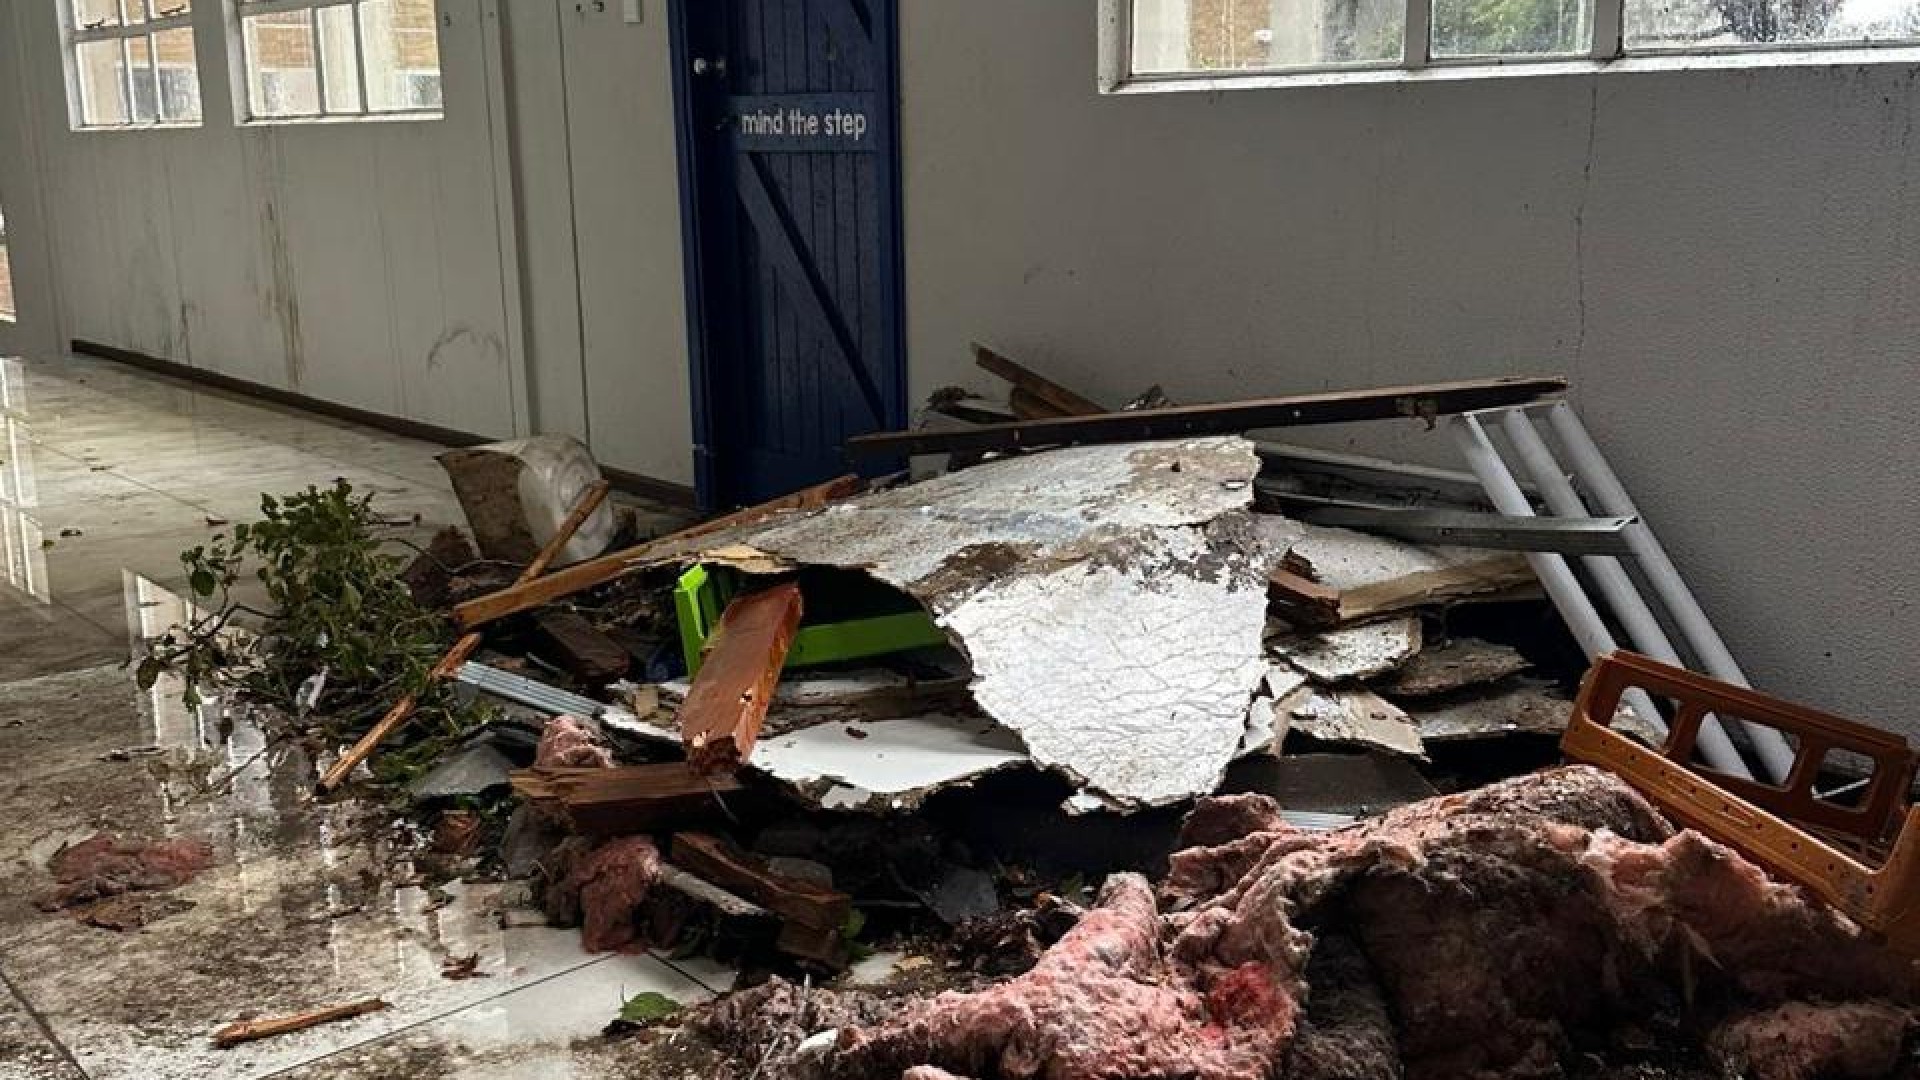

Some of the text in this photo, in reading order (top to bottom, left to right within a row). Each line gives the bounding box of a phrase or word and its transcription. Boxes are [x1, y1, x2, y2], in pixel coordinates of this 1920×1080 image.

[742, 108, 866, 140] mind the step
